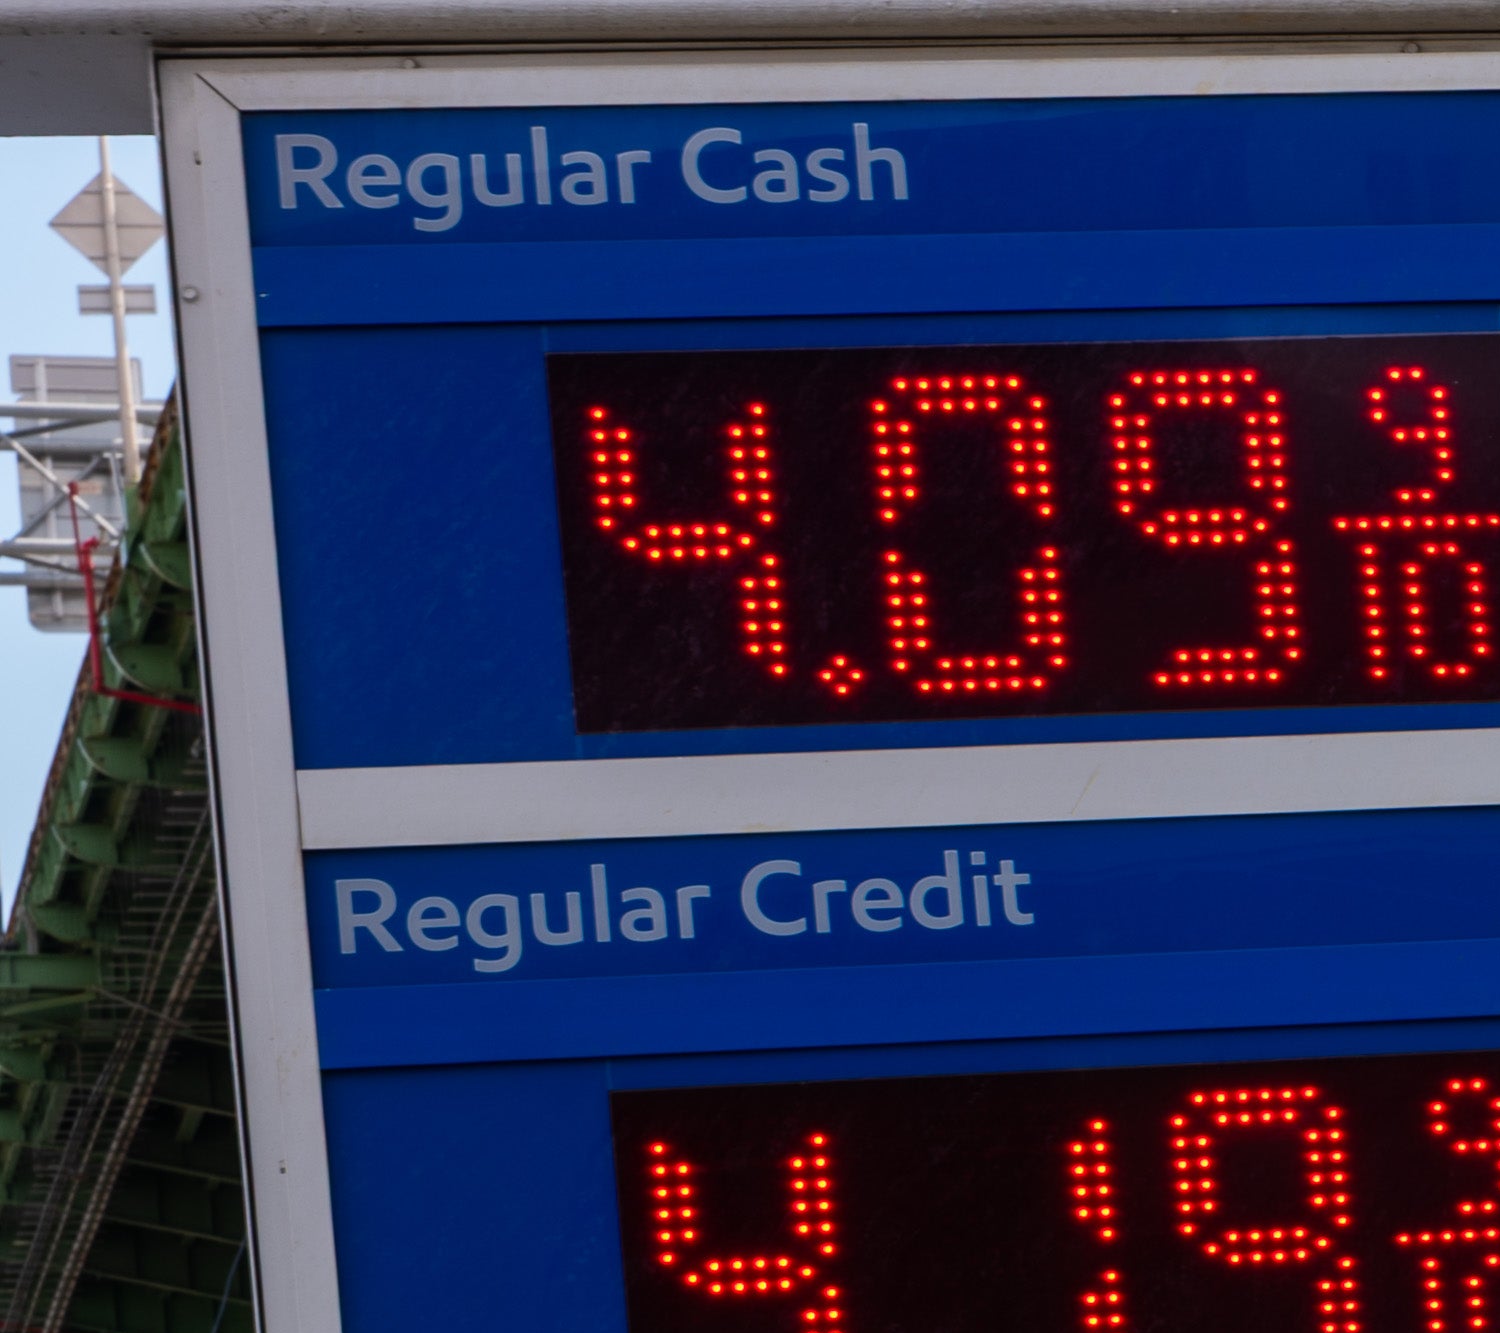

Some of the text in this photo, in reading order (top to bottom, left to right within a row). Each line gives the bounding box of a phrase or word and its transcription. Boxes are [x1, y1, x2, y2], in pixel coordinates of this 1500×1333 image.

[275, 122, 907, 232] Regular Cash
[587, 367, 1302, 697] 4.09
[335, 849, 1033, 973] Regular Credit
